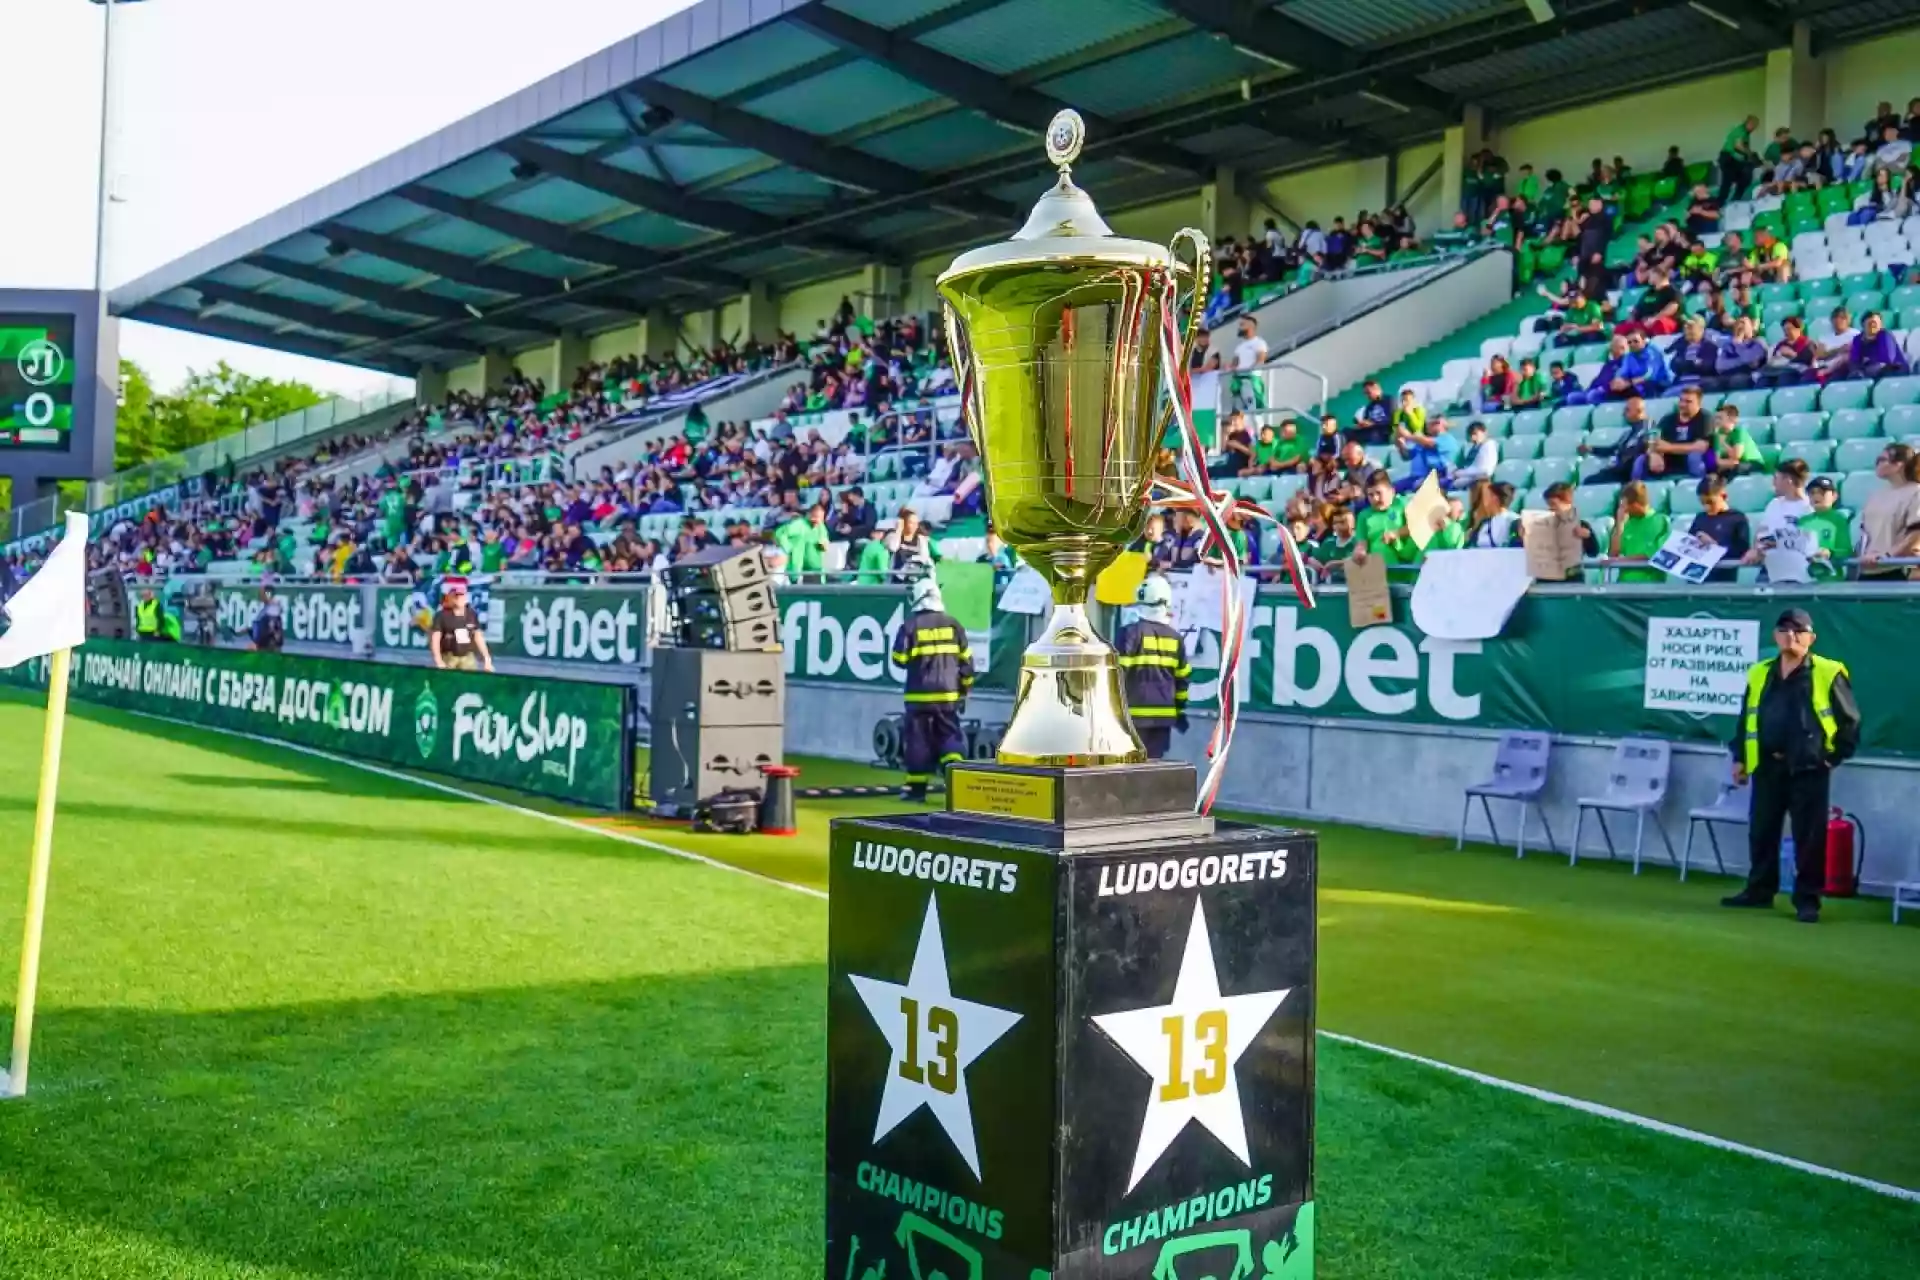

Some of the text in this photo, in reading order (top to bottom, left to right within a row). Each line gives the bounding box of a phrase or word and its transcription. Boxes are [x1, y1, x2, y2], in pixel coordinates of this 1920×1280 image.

[292, 593, 360, 642] efbet
[521, 597, 637, 663] efbet
[779, 600, 908, 683] fbet
[1665, 627, 1740, 641] ХАЗАРТЪТ
[1649, 658, 1667, 669] ОТ
[1662, 643, 1744, 657] НОСИ РИСК
[84, 652, 142, 691] ПОРЪЧАЙ
[143, 659, 203, 702] ОНЛАЙН
[218, 669, 276, 714] БЪРЗА
[1690, 676, 1709, 688] НА
[452, 690, 588, 786] Fan Shop
[853, 841, 1018, 894] LUDOGORETS
[1098, 849, 1289, 897] LUDOGORETS
[898, 996, 960, 1096] 13
[1159, 1009, 1228, 1103] 13
[857, 1161, 1004, 1241] CHAMPIONS
[1103, 1173, 1273, 1256] CHAMPIONS
